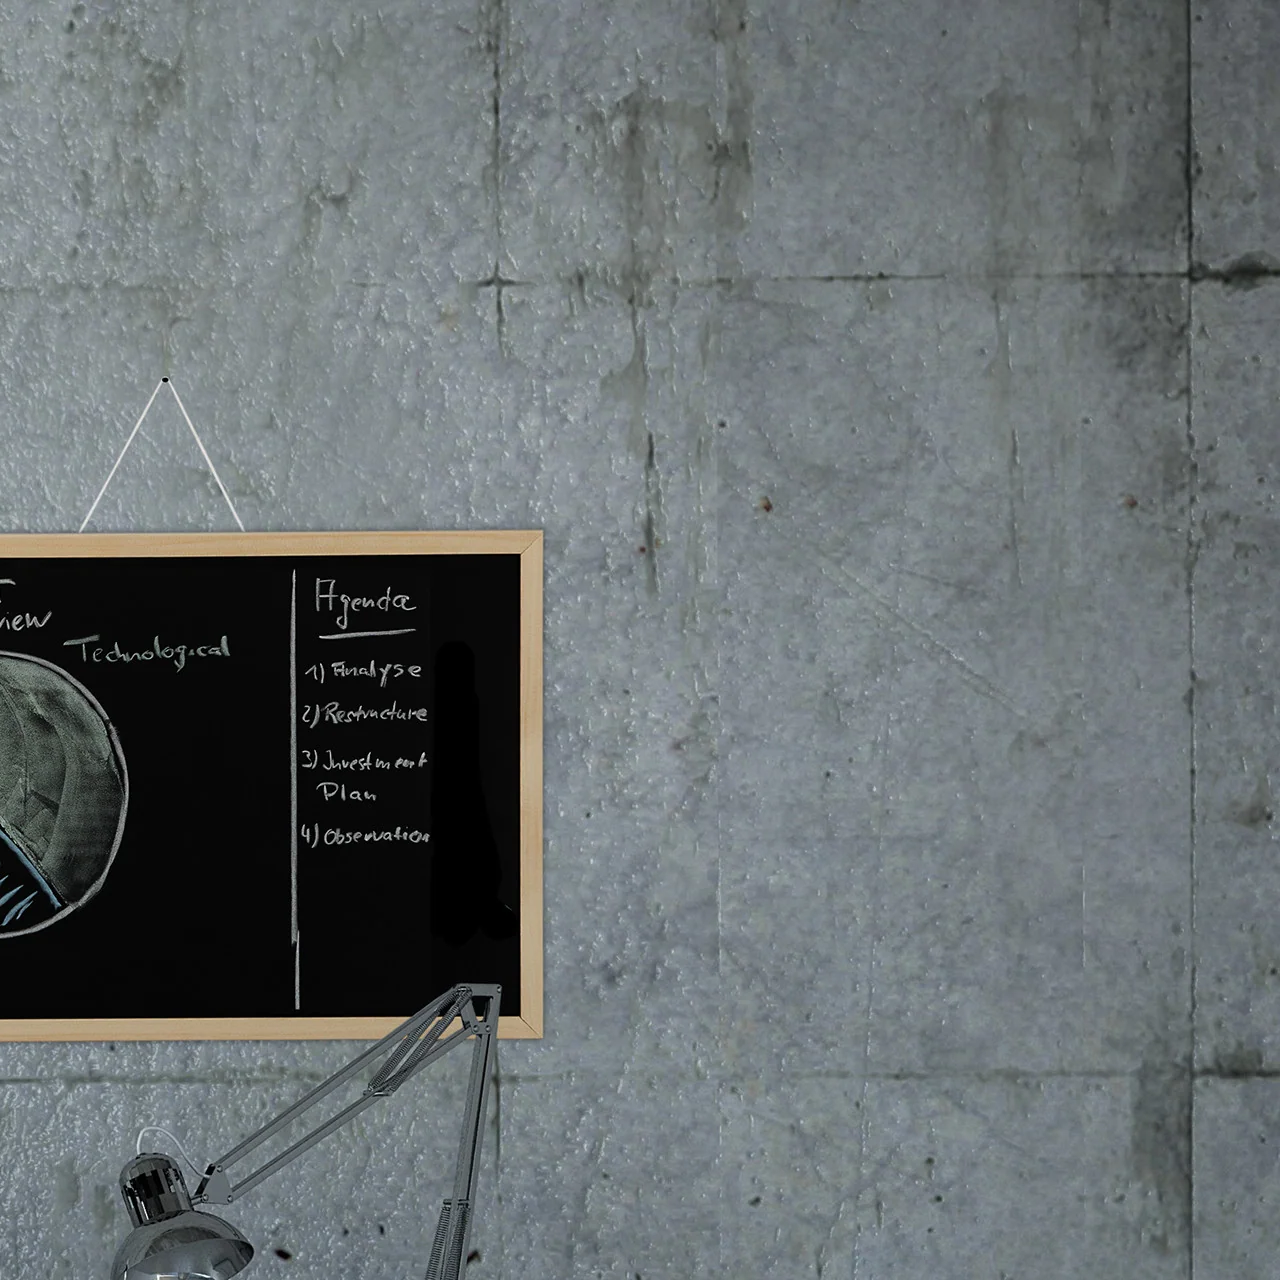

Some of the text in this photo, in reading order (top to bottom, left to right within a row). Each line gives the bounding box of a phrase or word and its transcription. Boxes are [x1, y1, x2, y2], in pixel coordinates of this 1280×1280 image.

[315, 578, 417, 630] Agenda
[63, 635, 230, 673] Technological
[331, 660, 421, 687] Analyse
[316, 782, 376, 800] Plan
[324, 827, 430, 845] Observation
